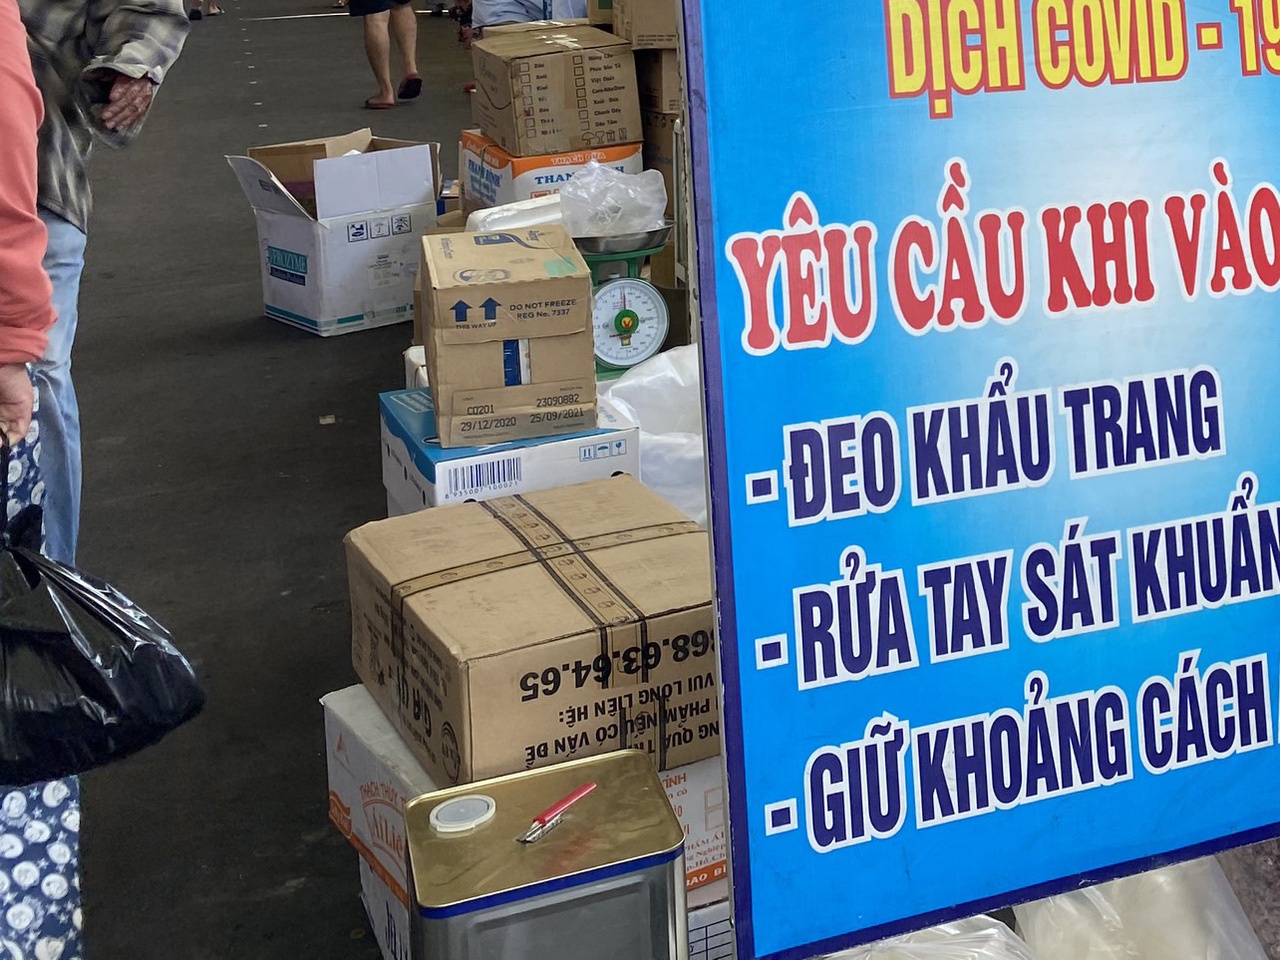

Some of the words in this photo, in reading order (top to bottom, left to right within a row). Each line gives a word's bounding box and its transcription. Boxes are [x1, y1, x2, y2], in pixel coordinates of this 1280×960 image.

[726, 191, 877, 356] YÊU
[888, 156, 1027, 335] CẦU
[1039, 192, 1155, 319] KHI
[509, 302, 524, 311] DO
[525, 301, 543, 310] NOT
[544, 298, 577, 308] FREEZE
[516, 311, 534, 319] REG
[551, 308, 570, 317] 7337
[460, 416, 517, 432] 29/12/2020
[529, 407, 584, 424] 25/09/2021
[536, 393, 580, 408] 23090882
[783, 411, 899, 528] ĐEO
[907, 356, 1054, 507] KHẨU
[1059, 364, 1226, 480] TRANG
[793, 544, 919, 691] RỬA
[917, 548, 1011, 663] TAY
[1022, 515, 1119, 643] SÁT
[519, 628, 716, 703] 68.63.64.65
[688, 672, 714, 689] VUI
[804, 711, 912, 855] GIỮ
[911, 670, 1134, 830] KHOẢNG
[1136, 647, 1269, 776] CÁCH
